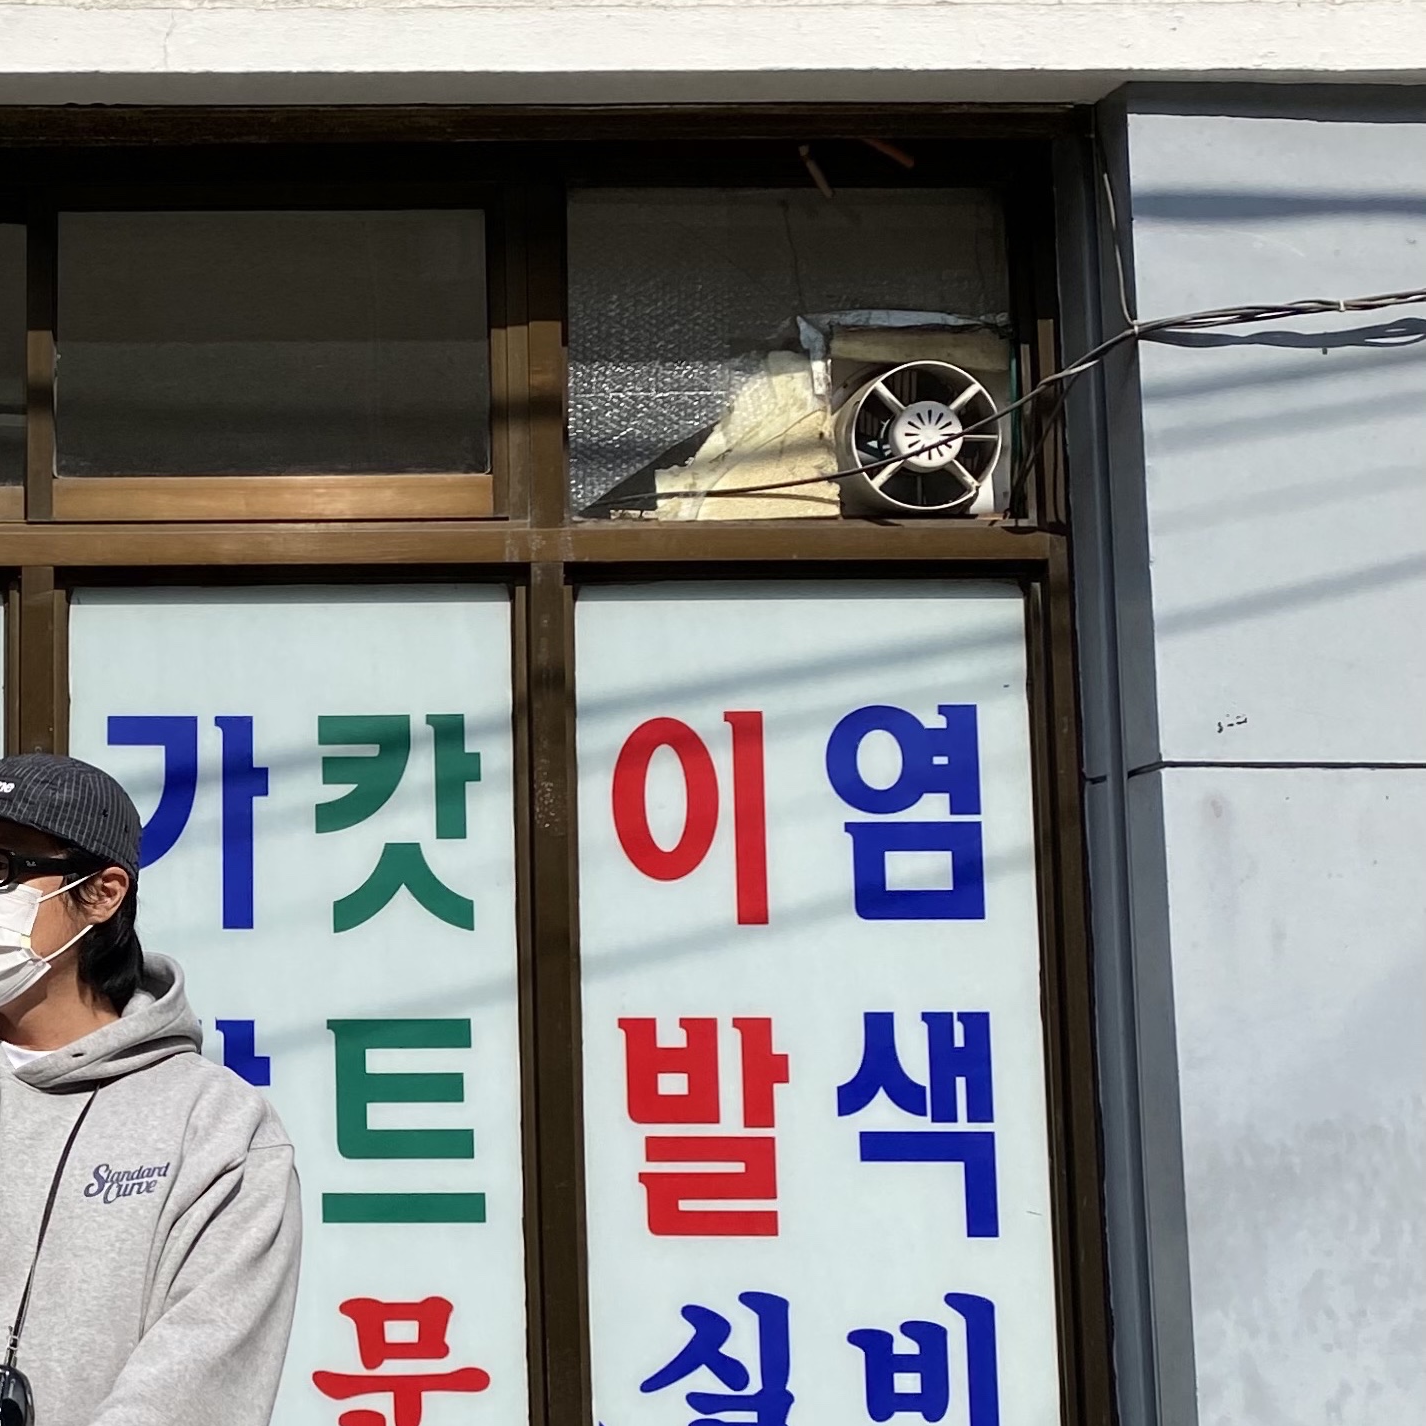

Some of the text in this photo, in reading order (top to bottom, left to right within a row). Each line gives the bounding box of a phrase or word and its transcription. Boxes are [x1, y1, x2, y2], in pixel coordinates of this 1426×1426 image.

[107, 715, 271, 1086] 가
[315, 714, 486, 1223] 캇트
[612, 711, 789, 1236] 이발
[826, 704, 1000, 1238] 염색
[84, 1162, 170, 1197] Standard
[103, 1180, 157, 1204] Curve
